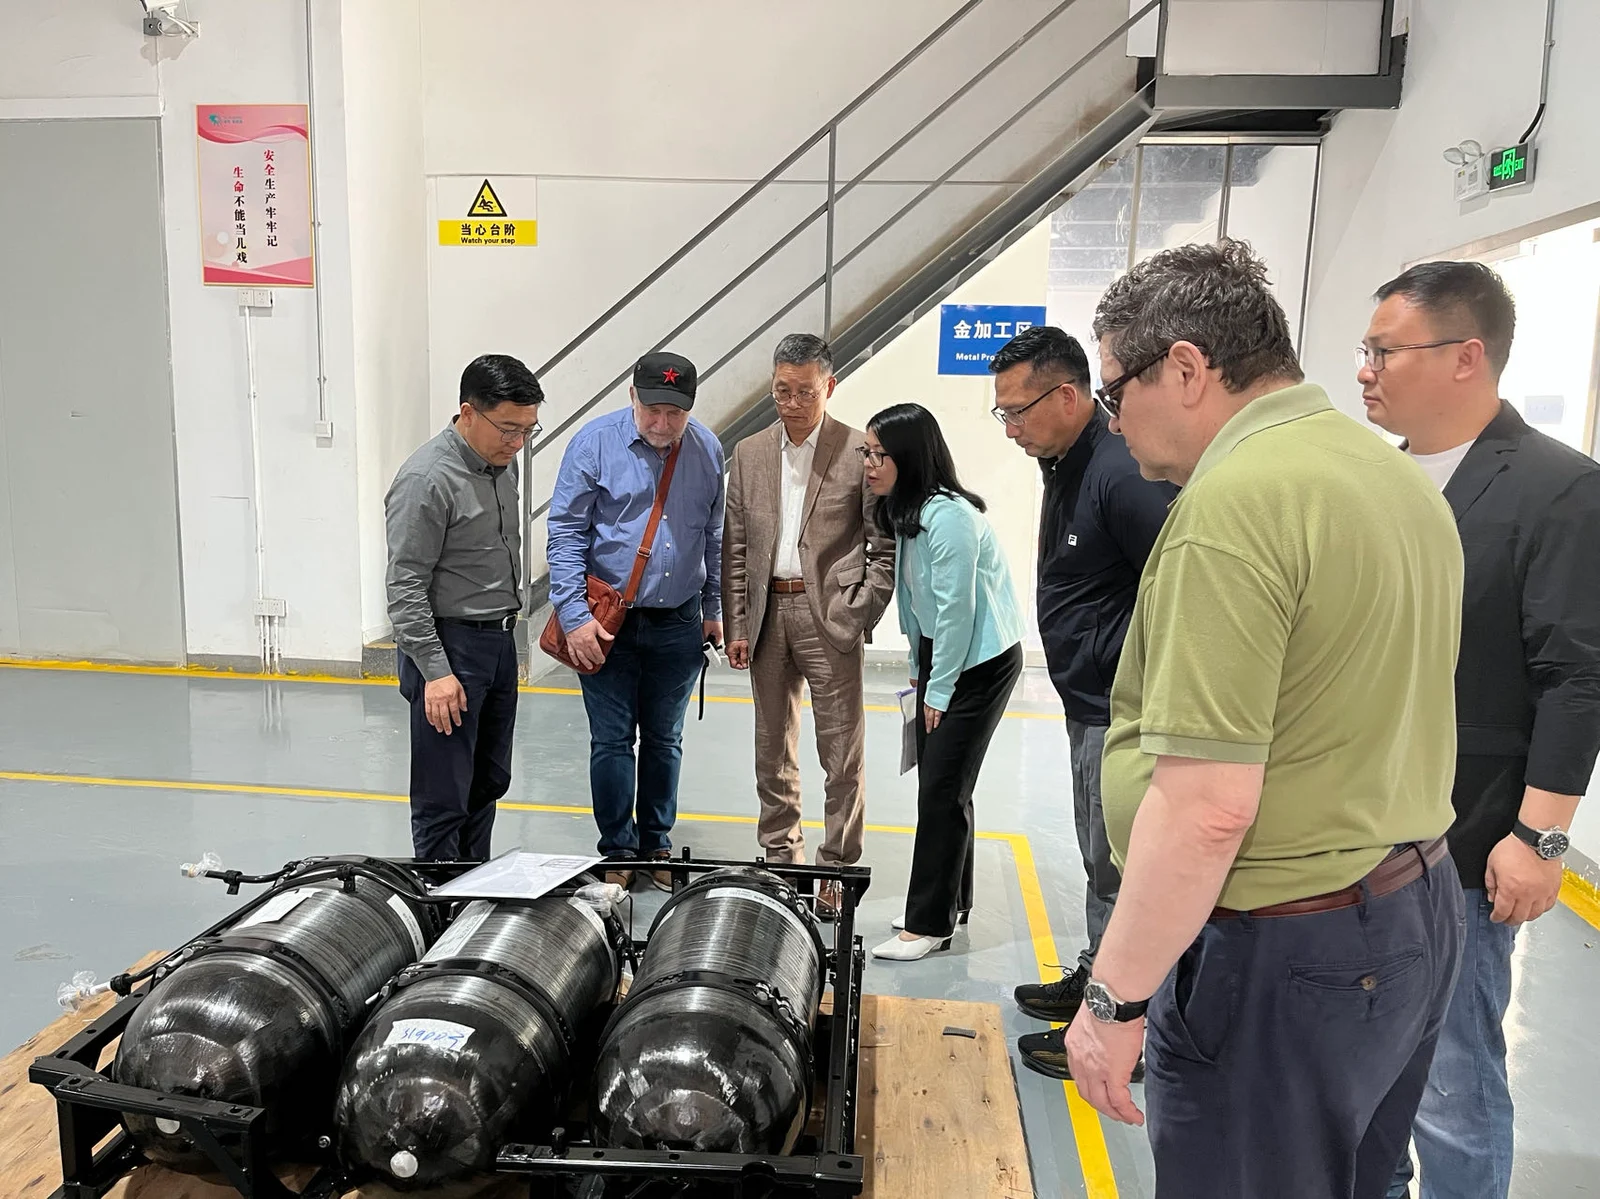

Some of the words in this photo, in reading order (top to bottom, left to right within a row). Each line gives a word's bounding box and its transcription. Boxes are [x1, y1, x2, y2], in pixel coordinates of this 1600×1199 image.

[263, 149, 278, 247] 安全生产牢牢记
[233, 166, 248, 264] 生命不能当儿戏
[461, 223, 516, 236] 当心台阶
[501, 237, 516, 245] step
[956, 353, 980, 361] Metal
[981, 353, 996, 361] Pro
